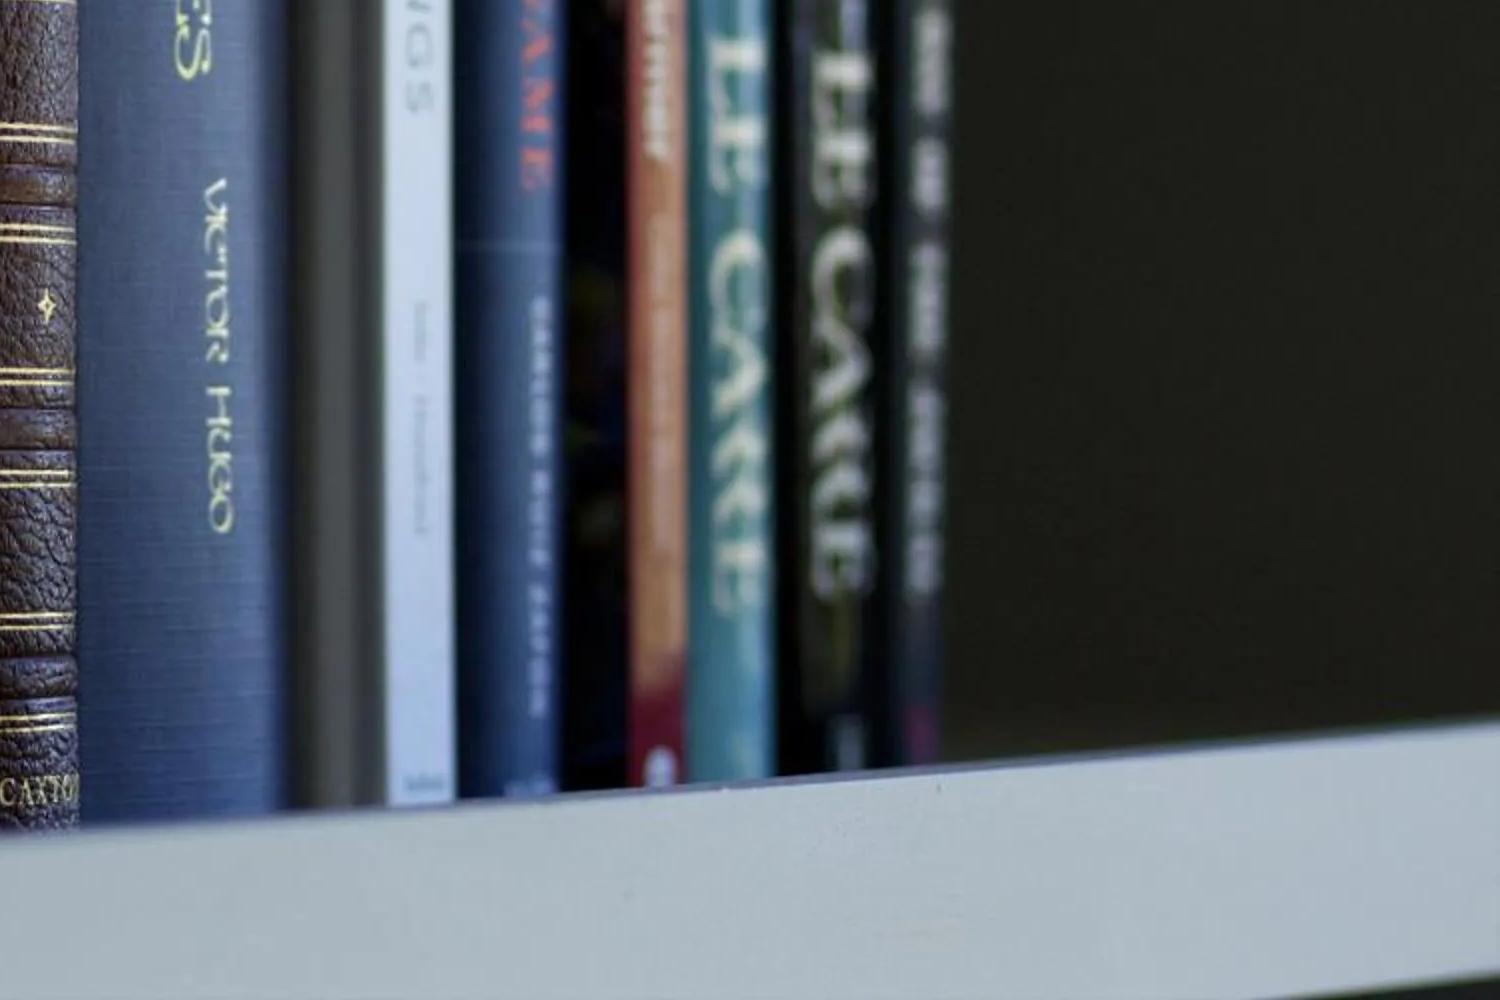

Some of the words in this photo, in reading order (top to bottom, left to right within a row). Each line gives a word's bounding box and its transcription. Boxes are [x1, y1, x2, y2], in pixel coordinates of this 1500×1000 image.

[708, 33, 771, 195] LE
[809, 47, 877, 208] LE
[202, 176, 230, 364] VICTOR
[204, 385, 235, 534] HUGO
